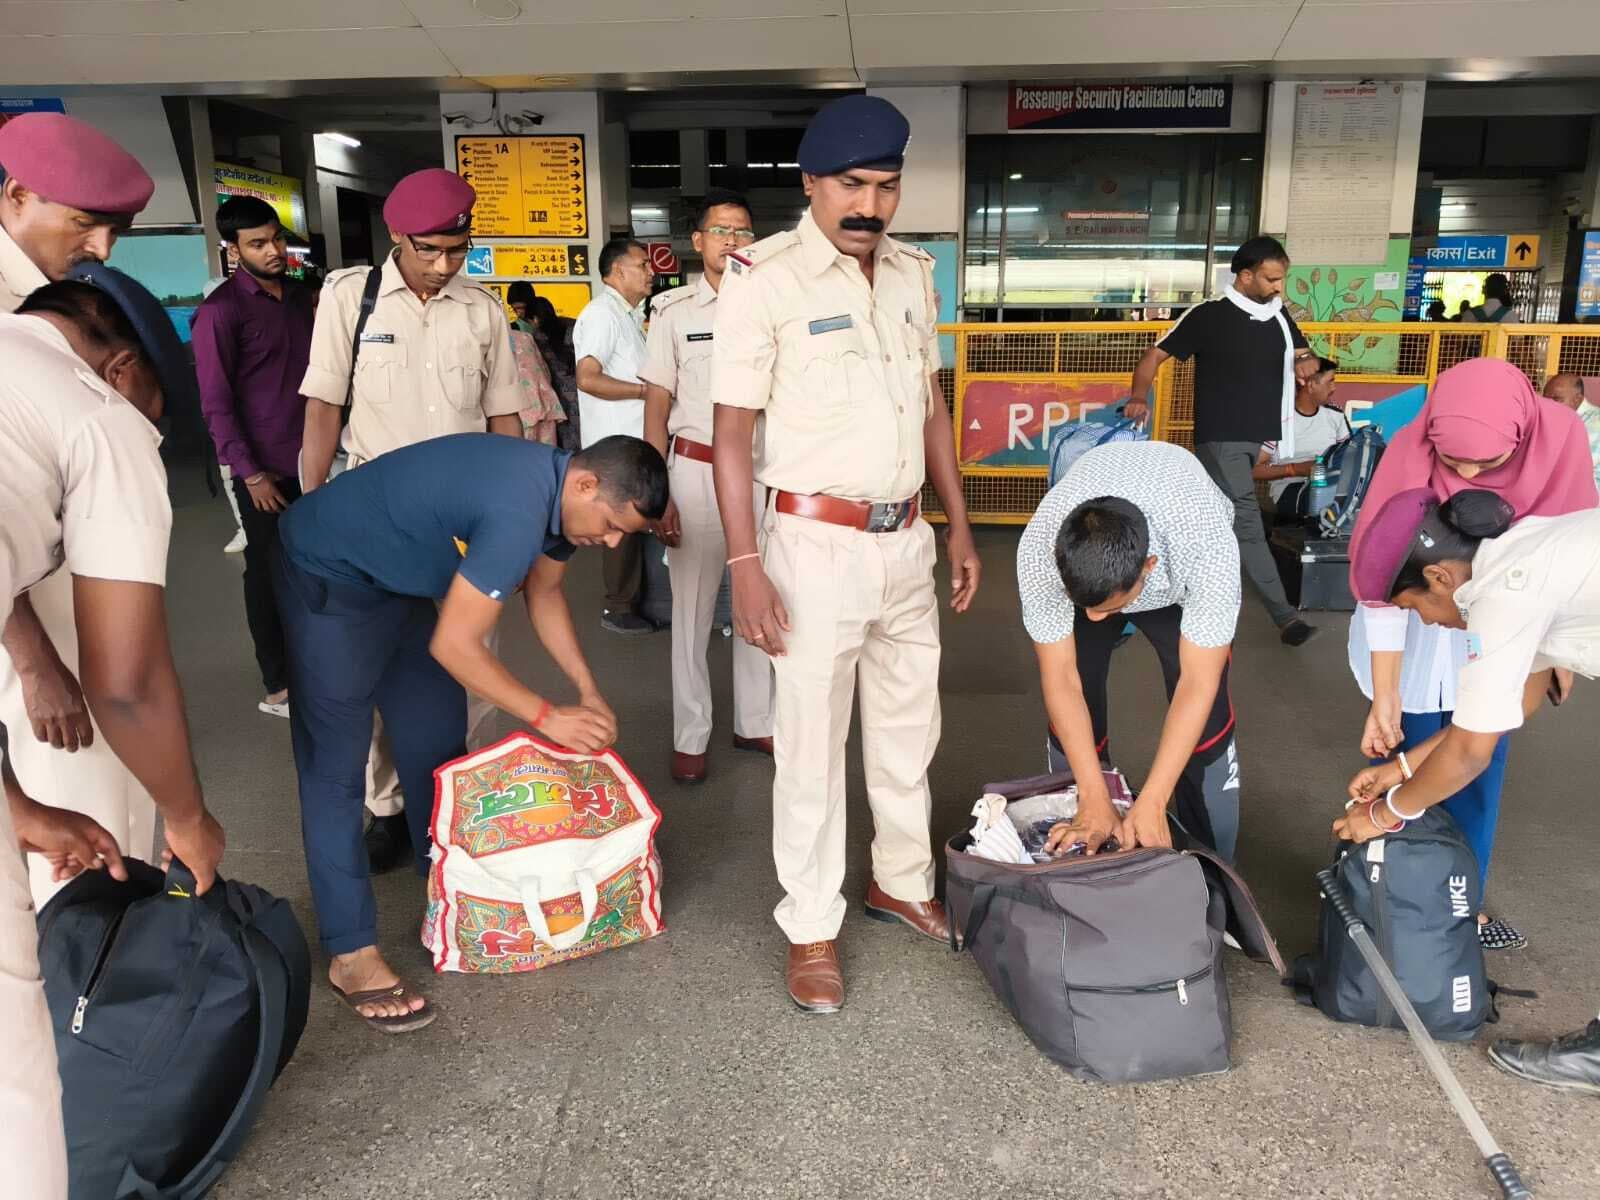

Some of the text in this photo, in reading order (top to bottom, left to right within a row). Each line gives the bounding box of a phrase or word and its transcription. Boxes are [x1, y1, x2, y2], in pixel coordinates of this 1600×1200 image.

[1015, 85, 1225, 112] Passenger Security Facilitation Centre
[495, 143, 509, 154] 1A
[1467, 247, 1497, 260] Exit
[471, 781, 617, 825] विमल
[1450, 875, 1470, 917] NIKE
